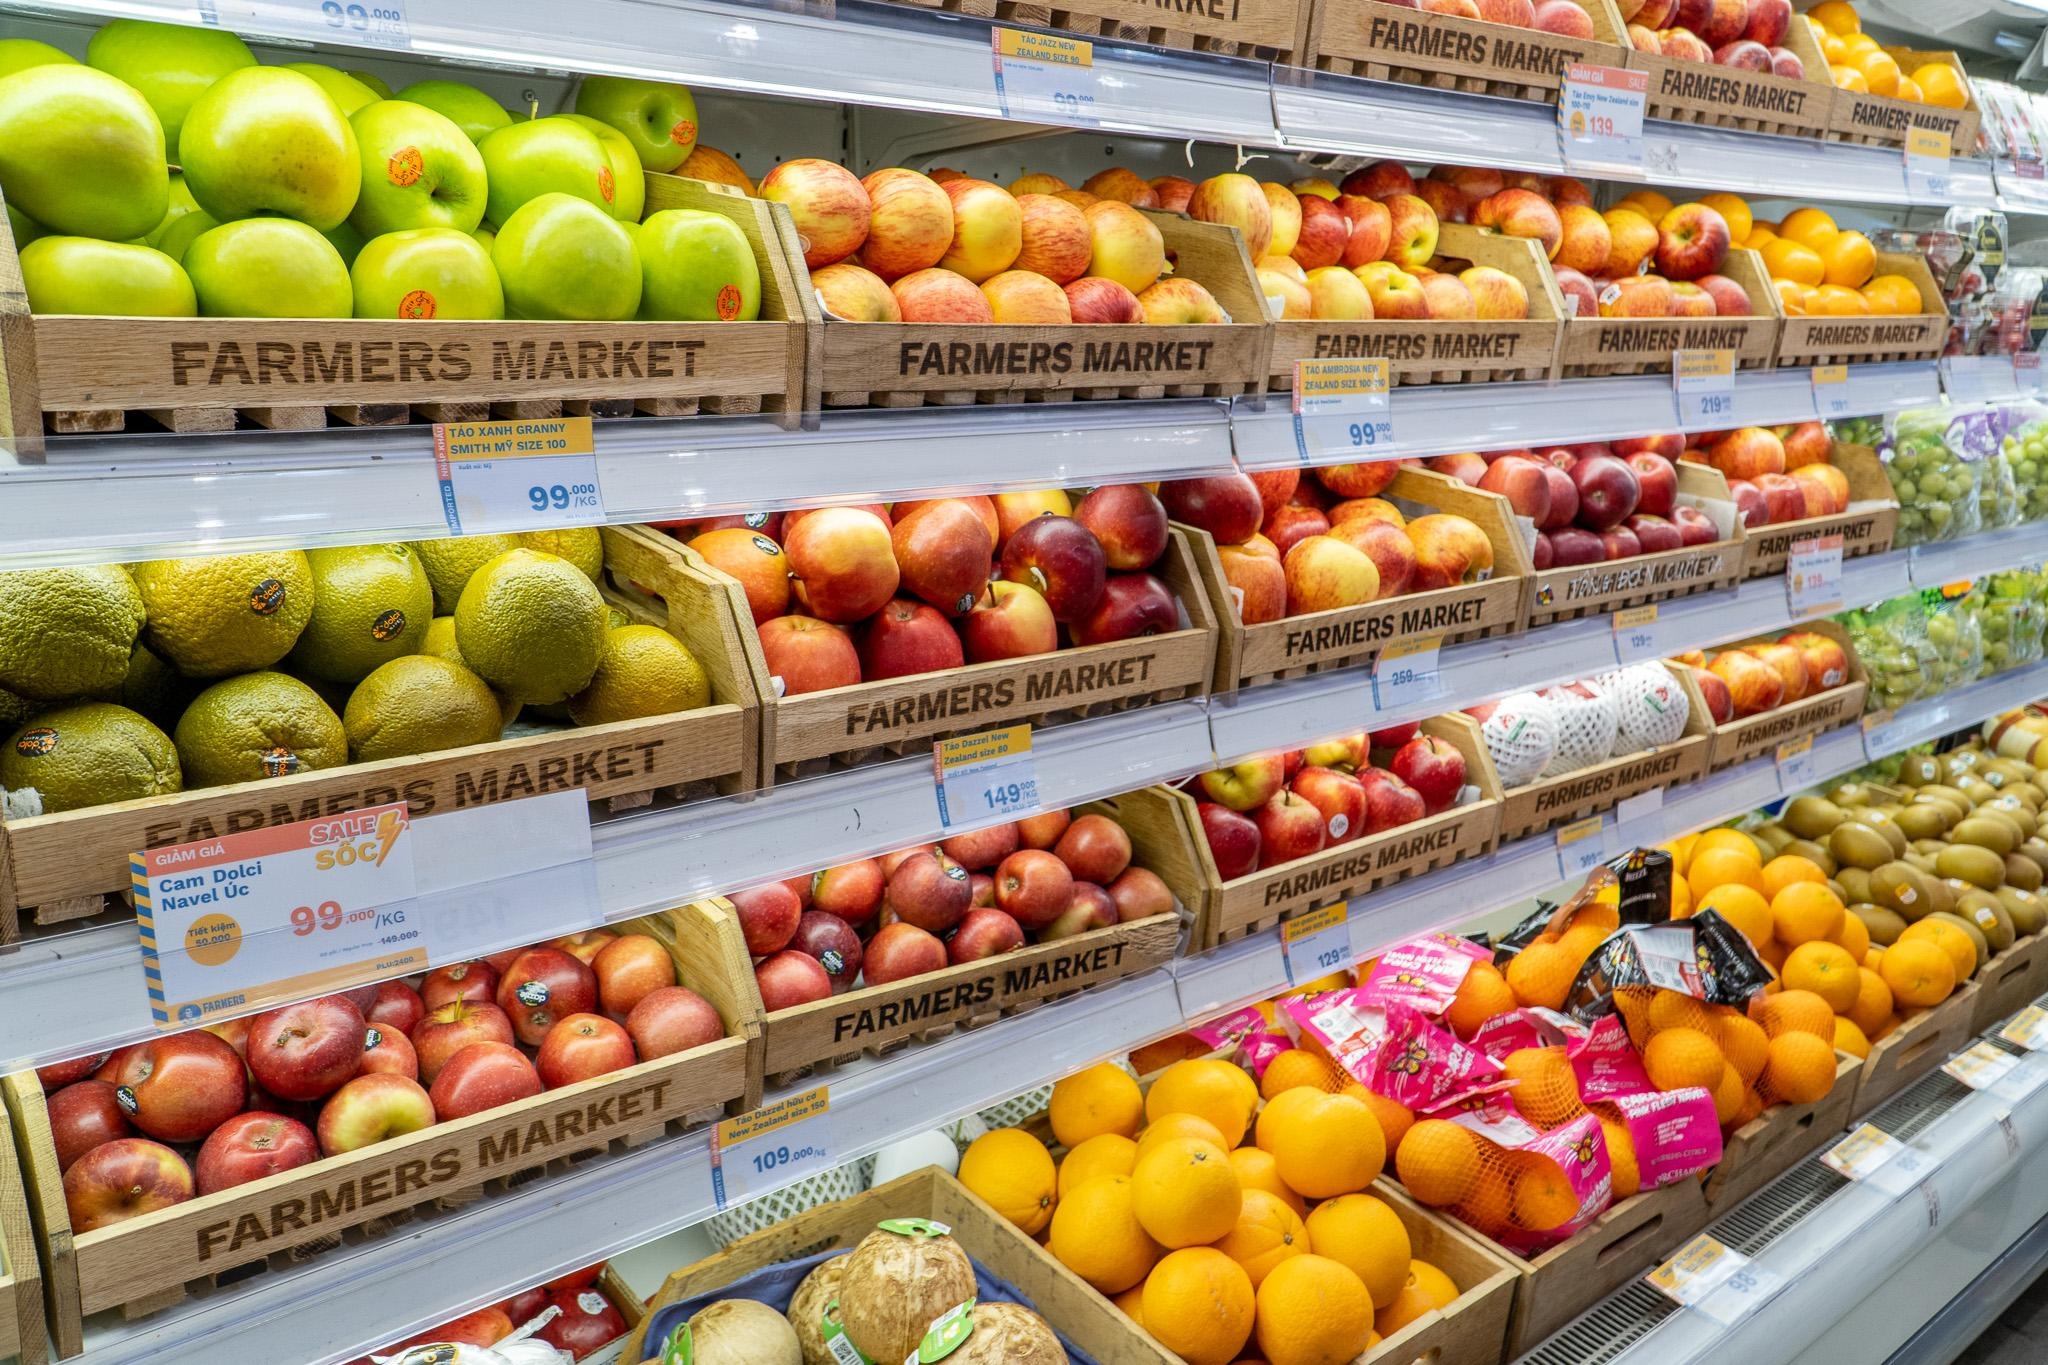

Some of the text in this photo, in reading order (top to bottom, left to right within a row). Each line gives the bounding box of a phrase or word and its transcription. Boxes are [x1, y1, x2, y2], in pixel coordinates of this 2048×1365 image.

[321, 0, 369, 31] 99
[1016, 47, 1051, 60] ZEALAND
[1052, 52, 1069, 63] SIZE
[1038, 38, 1057, 49] JAZZ
[1058, 41, 1076, 51] NEW
[1369, 17, 1584, 77] FARMERS MARKET
[1660, 69, 1807, 116] FARMERS MARKET
[1590, 116, 1613, 137] 139
[1851, 102, 1912, 133] FARMERS
[1313, 333, 1520, 361] FARMERS MARKET
[1598, 327, 1749, 354] FARMERS MARKET
[1806, 326, 1869, 347] FARMERS
[170, 340, 707, 387] FARMERS MARKET
[899, 341, 1215, 376] FARMERS MARKET
[1305, 380, 1340, 391] ZEALAND
[1701, 396, 1722, 414] 219
[448, 423, 566, 438] TÁO XANH GRANNY
[1349, 422, 1376, 446] 99
[450, 443, 491, 455] SMITH
[516, 441, 543, 451] SIZE
[546, 439, 567, 449] 100
[528, 484, 570, 512] 99
[574, 495, 598, 509] /KG
[1286, 596, 1488, 657] FARMERS MARKET
[846, 653, 1157, 736] FARMERS MARKET
[1736, 699, 1846, 750] FARMERS MARKET
[961, 735, 989, 748] Dazzel
[991, 733, 1009, 742] New
[943, 750, 978, 766] Zealand
[980, 747, 996, 757] size
[454, 738, 666, 808] MARKET
[1534, 751, 1683, 814] FARMERS MARKET
[984, 784, 1020, 809] 149
[309, 814, 377, 846] SALE
[199, 842, 226, 858] GIÁ
[314, 836, 379, 871] SỐC
[159, 861, 264, 893] Cam Dolci
[1263, 823, 1464, 907] FARMERS MARKET
[161, 881, 250, 912] Navel Úc
[290, 900, 407, 937] 99 .000 /KG
[195, 932, 232, 947] 50.000
[1317, 948, 1340, 968] 129
[833, 941, 1130, 1043] FARMERS MARKET
[728, 1099, 826, 1140] New Zealand size 150
[754, 1104, 785, 1120] Dazzel
[197, 1079, 673, 1262] FARMERS MARKET
[753, 1146, 790, 1174] 109
[790, 1146, 814, 1162] .000
